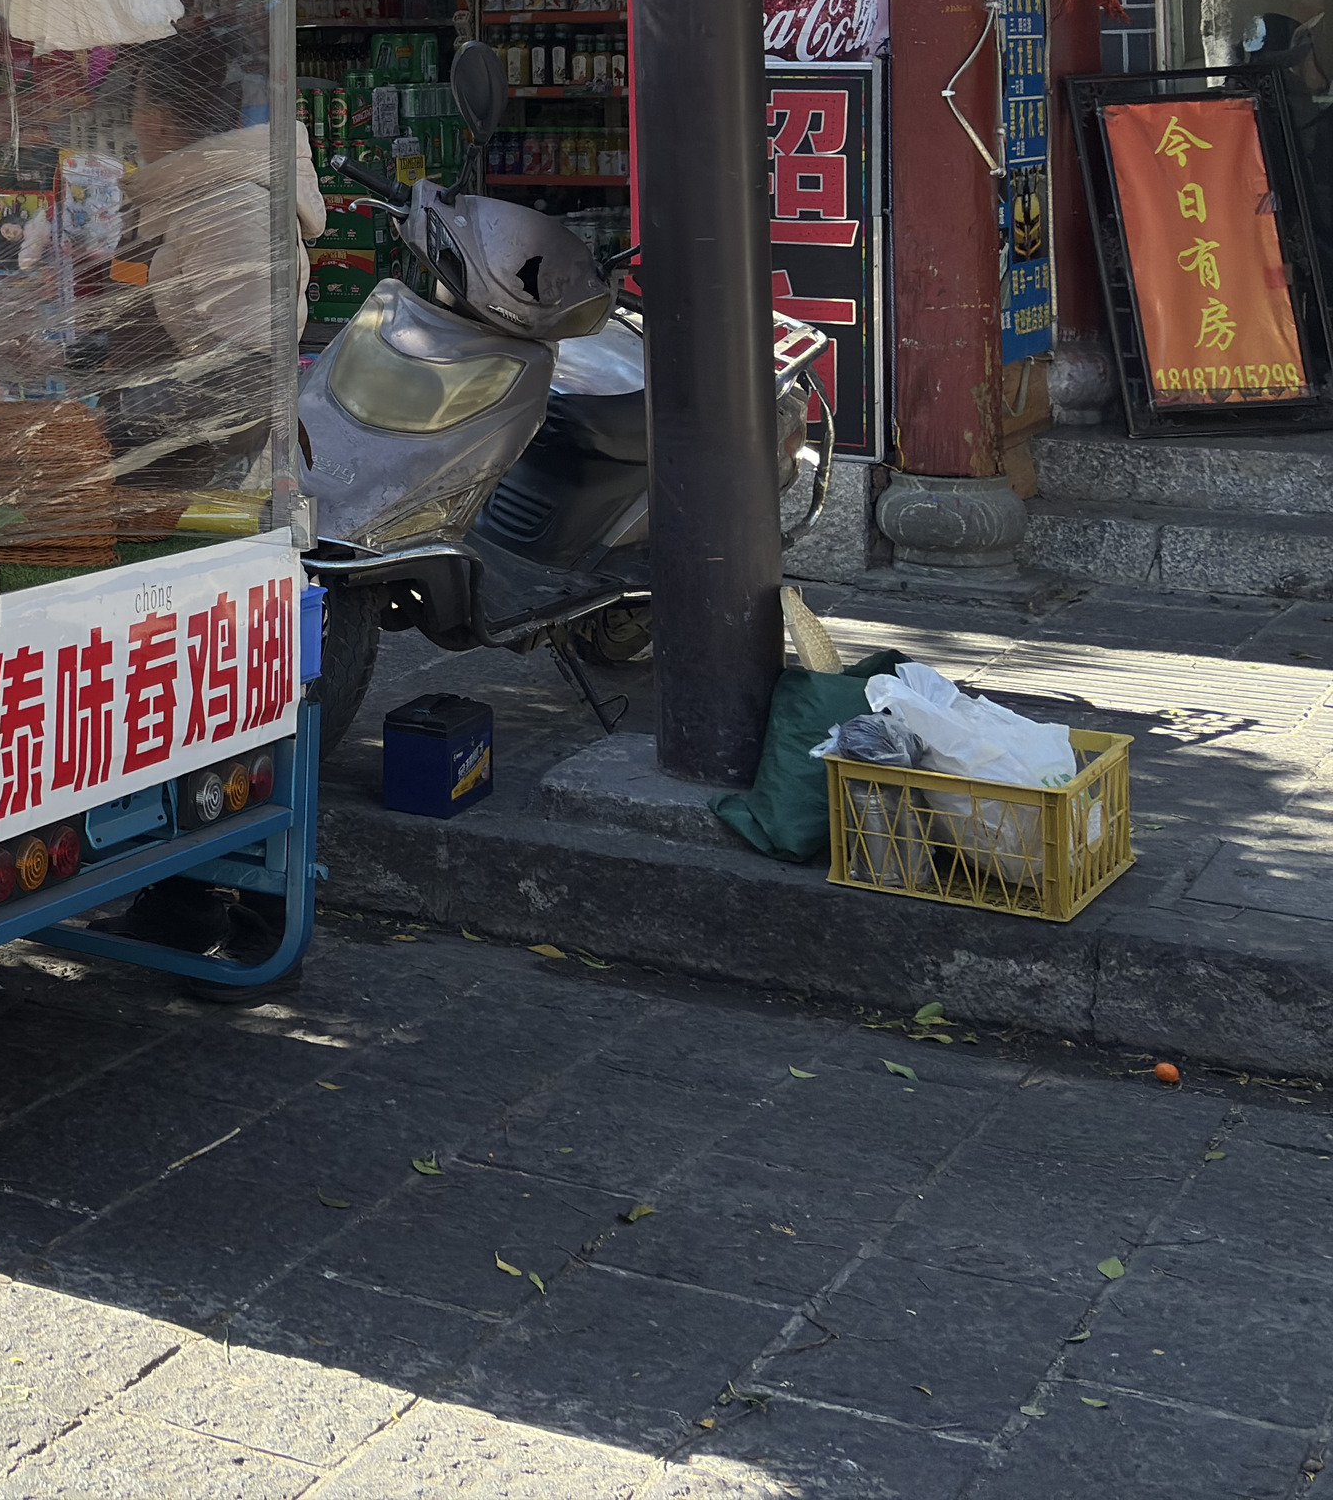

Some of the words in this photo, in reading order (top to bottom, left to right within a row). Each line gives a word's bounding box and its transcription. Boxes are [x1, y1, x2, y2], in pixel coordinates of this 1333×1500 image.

[1155, 116, 1237, 350] 今日有房
[134, 583, 173, 614] chōng
